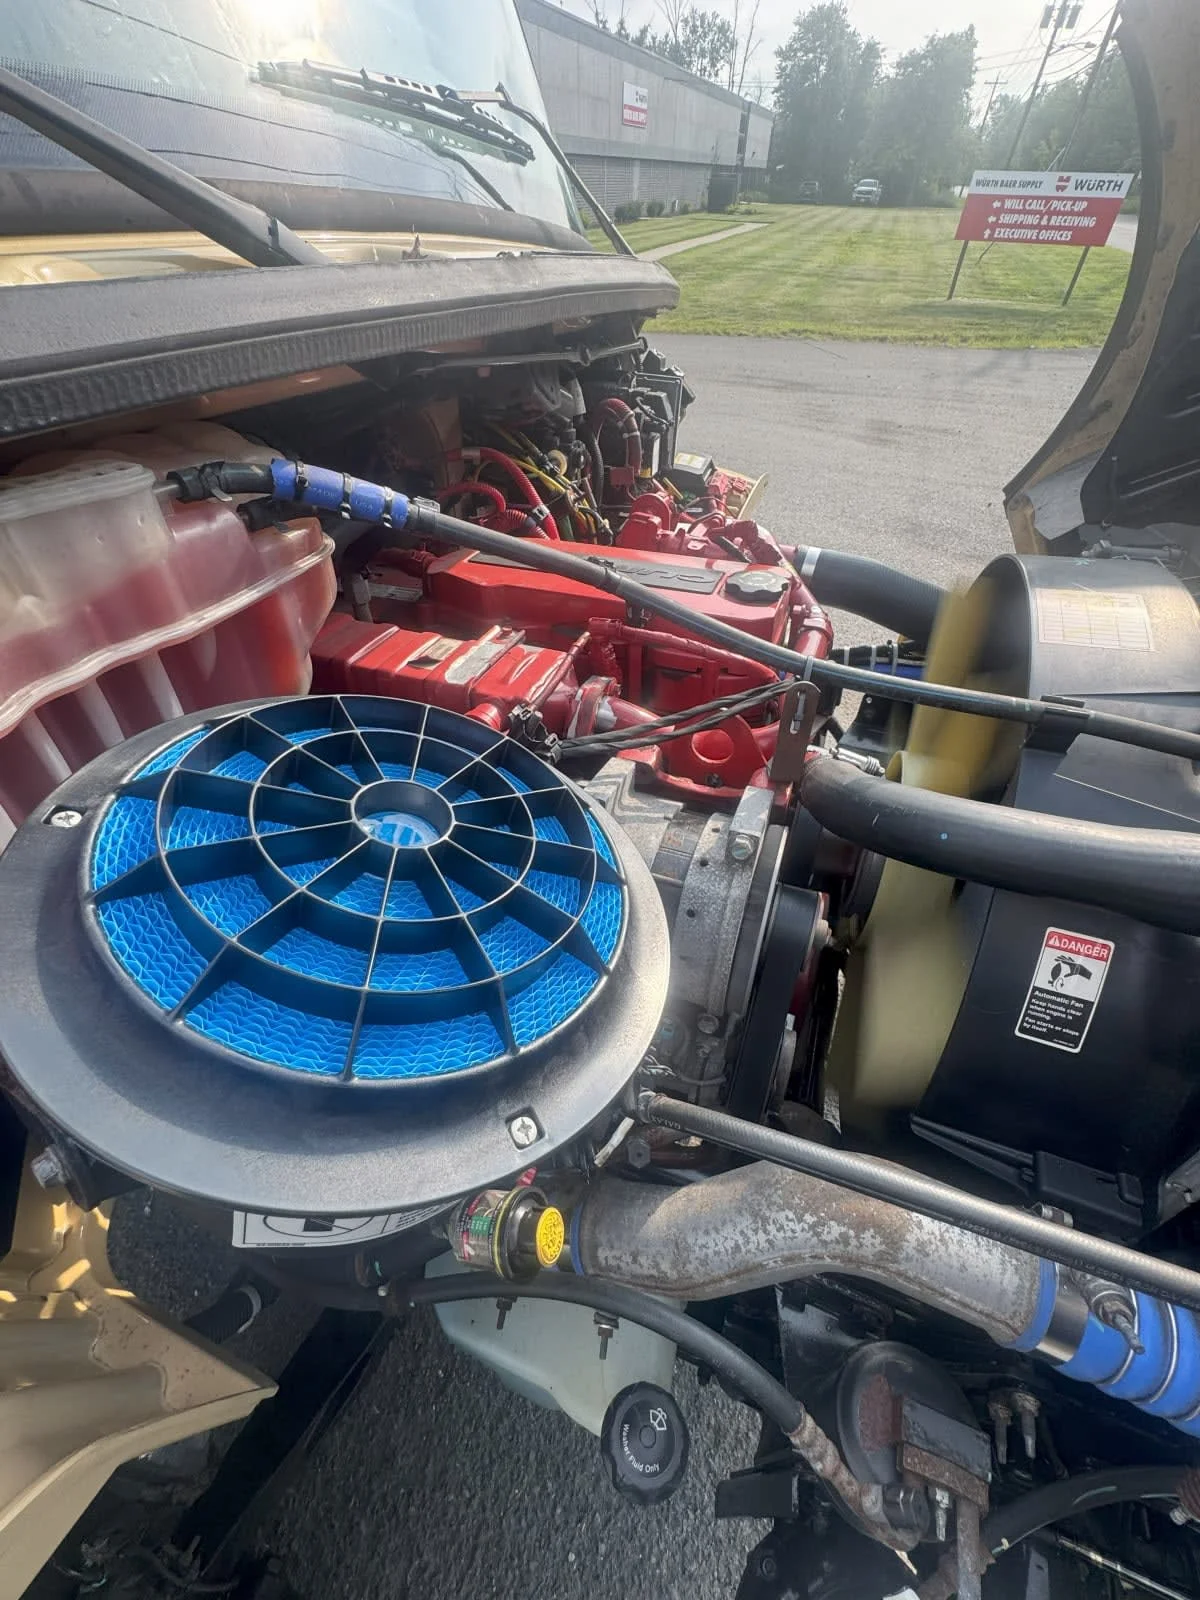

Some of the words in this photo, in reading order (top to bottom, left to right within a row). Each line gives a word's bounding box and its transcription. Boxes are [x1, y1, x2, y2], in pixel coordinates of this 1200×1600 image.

[1018, 180, 1044, 189] SUPPLY
[1074, 179, 1124, 192] WÜRTH
[1004, 200, 1024, 210] WILL
[1025, 200, 1088, 212] CALL/PICK-UP
[998, 214, 1040, 225] SHIPPING
[1041, 216, 1048, 225] &
[1049, 216, 1097, 227] RECEIVING
[994, 229, 1038, 239] EXECUTIVE
[1039, 230, 1073, 241] OFFICES
[1060, 938, 1109, 959] DANGER
[1034, 990, 1070, 1005] Automatic
[1071, 1000, 1084, 1009] Fan
[622, 1423, 631, 1456] Washer
[628, 1455, 644, 1473] Fluid
[645, 1463, 660, 1473] Only
